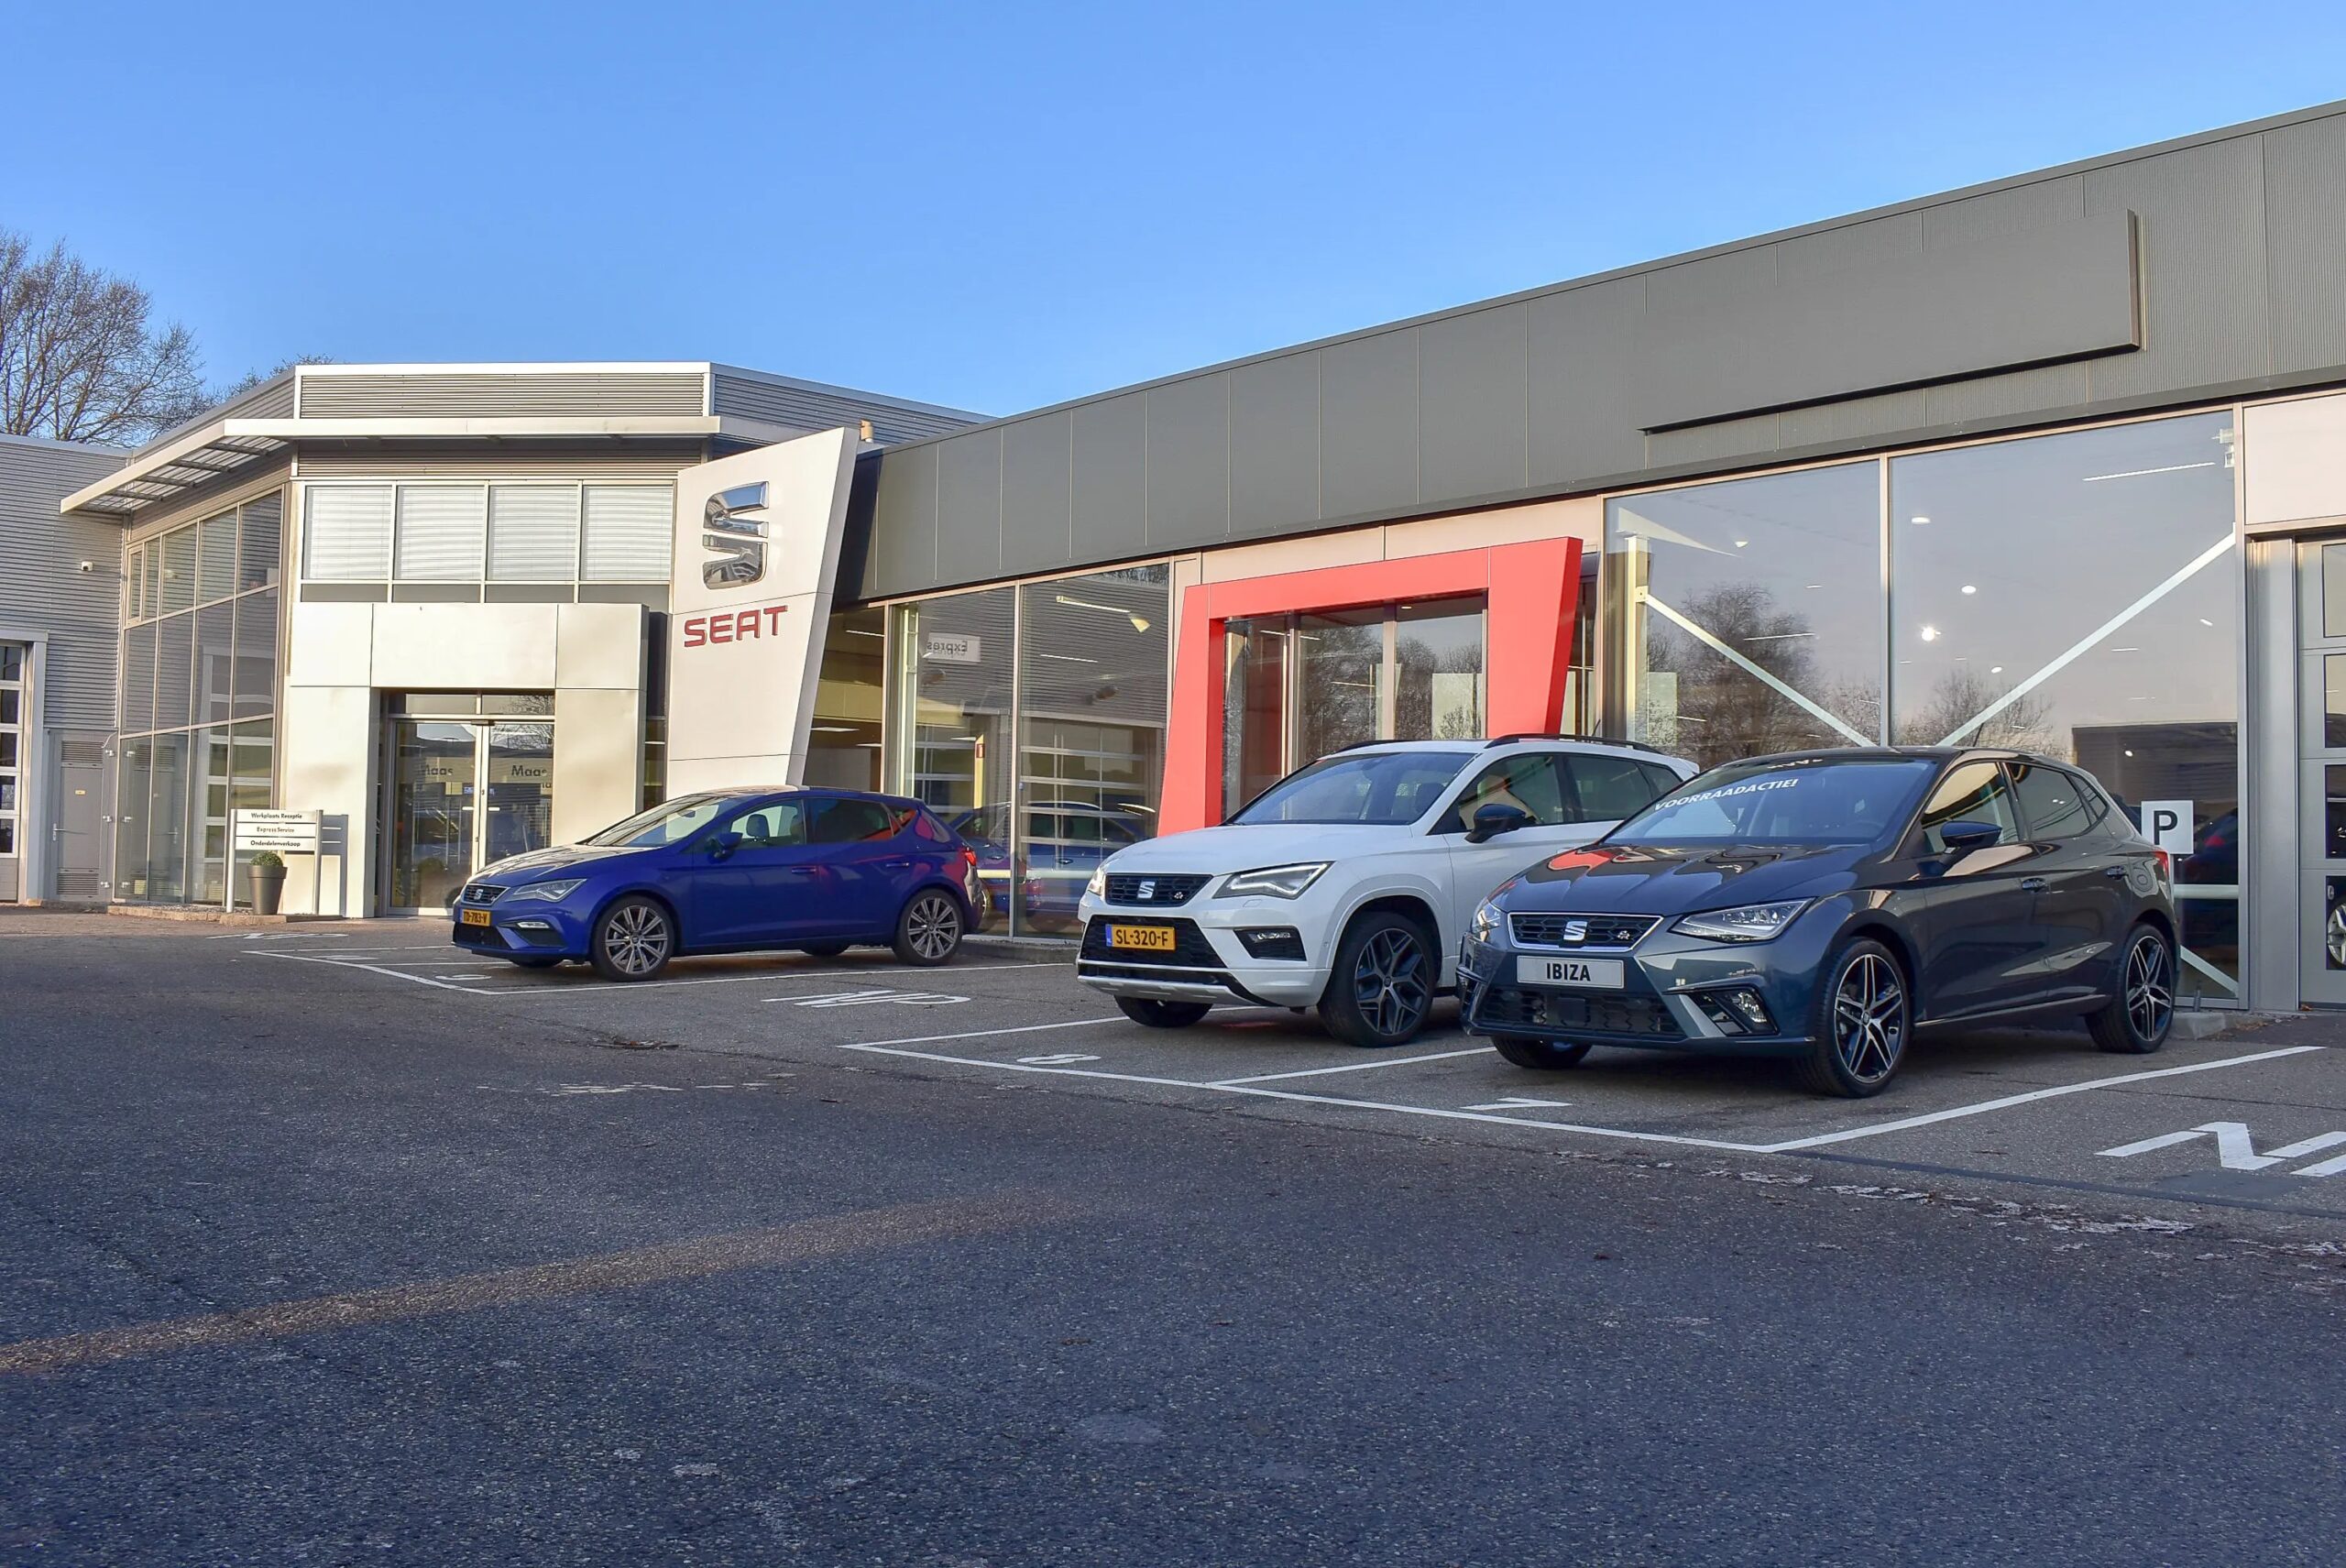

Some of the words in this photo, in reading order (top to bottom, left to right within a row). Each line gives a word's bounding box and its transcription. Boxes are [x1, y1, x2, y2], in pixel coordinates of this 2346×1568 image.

[684, 605, 788, 647] SEAT
[1654, 778, 1799, 811] VOORRAADACTIE!
[2154, 810, 2178, 845] P
[1115, 929, 1168, 946] SL-320-F
[1546, 962, 1592, 981] IBIZA
